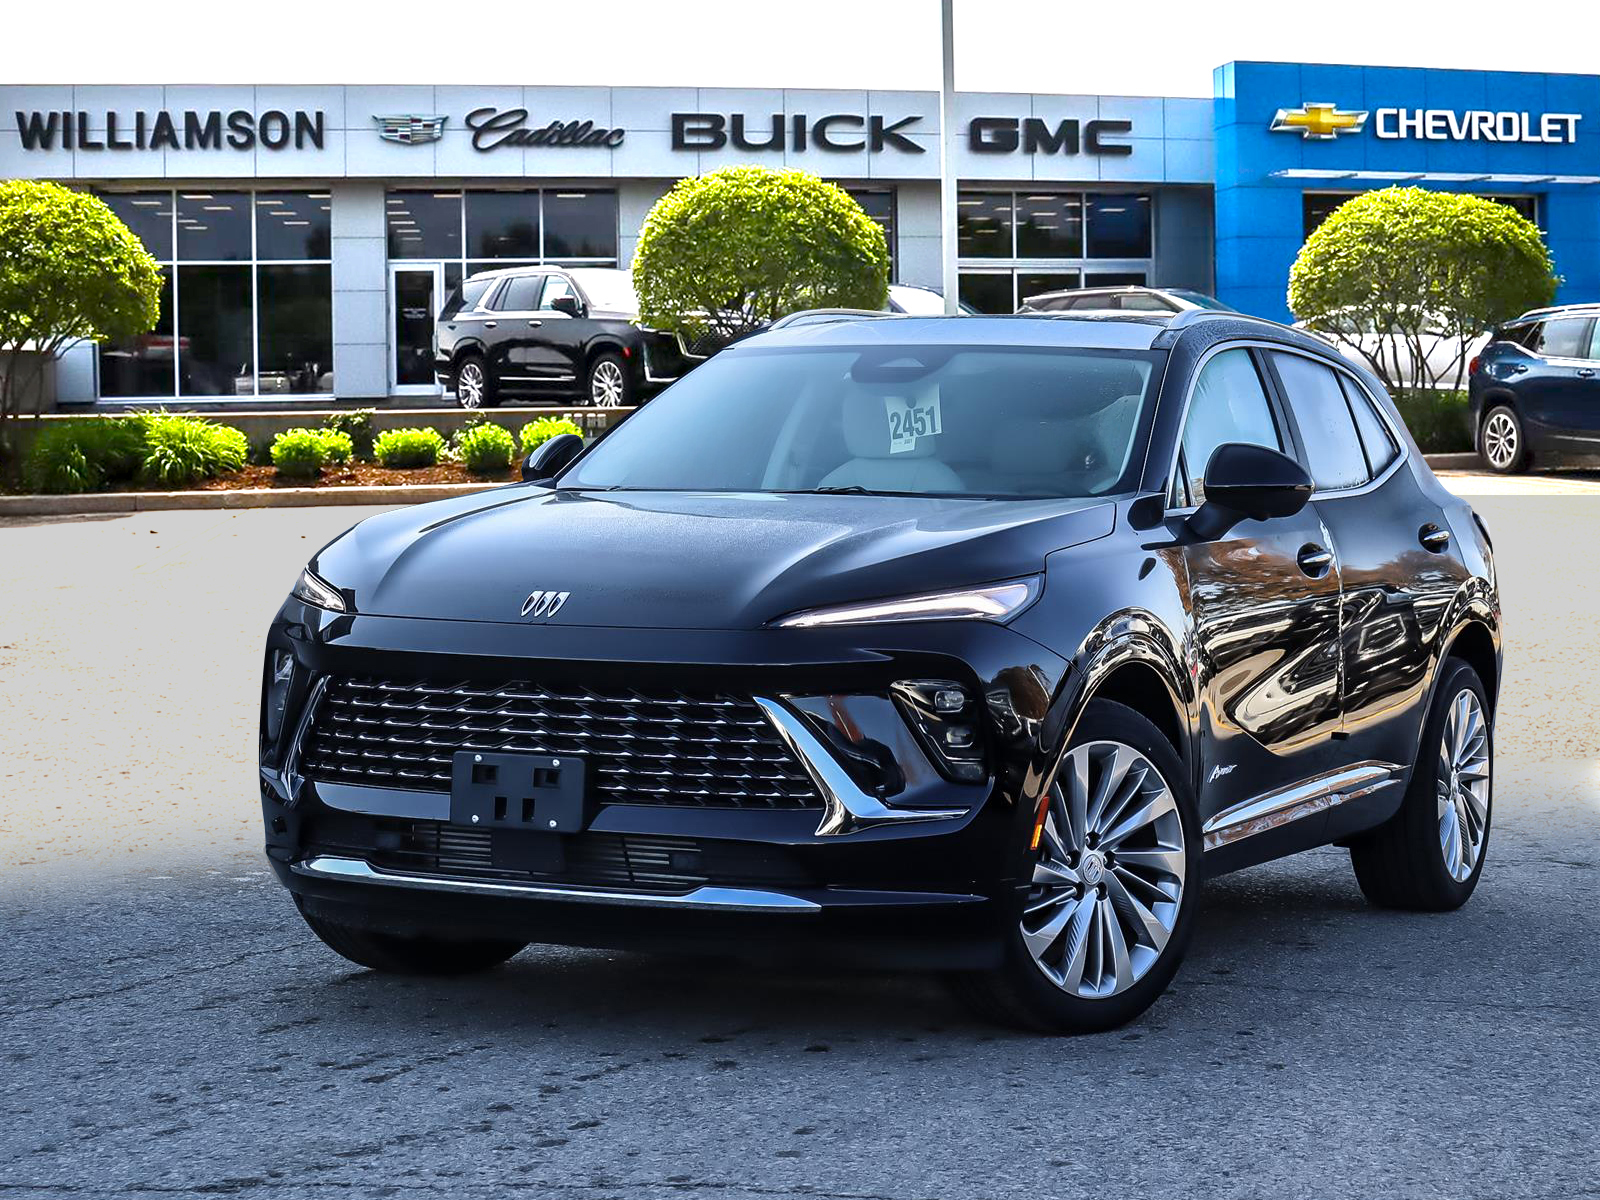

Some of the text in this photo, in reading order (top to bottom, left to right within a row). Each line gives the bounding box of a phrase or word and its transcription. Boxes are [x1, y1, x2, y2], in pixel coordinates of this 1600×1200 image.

[15, 110, 324, 150] WILLIAMSON
[465, 107, 625, 151] Cadillac
[671, 112, 927, 154] BUICK
[970, 117, 1132, 155] GMC
[1375, 108, 1582, 143] CHEVROLET
[890, 406, 937, 440] 2451
